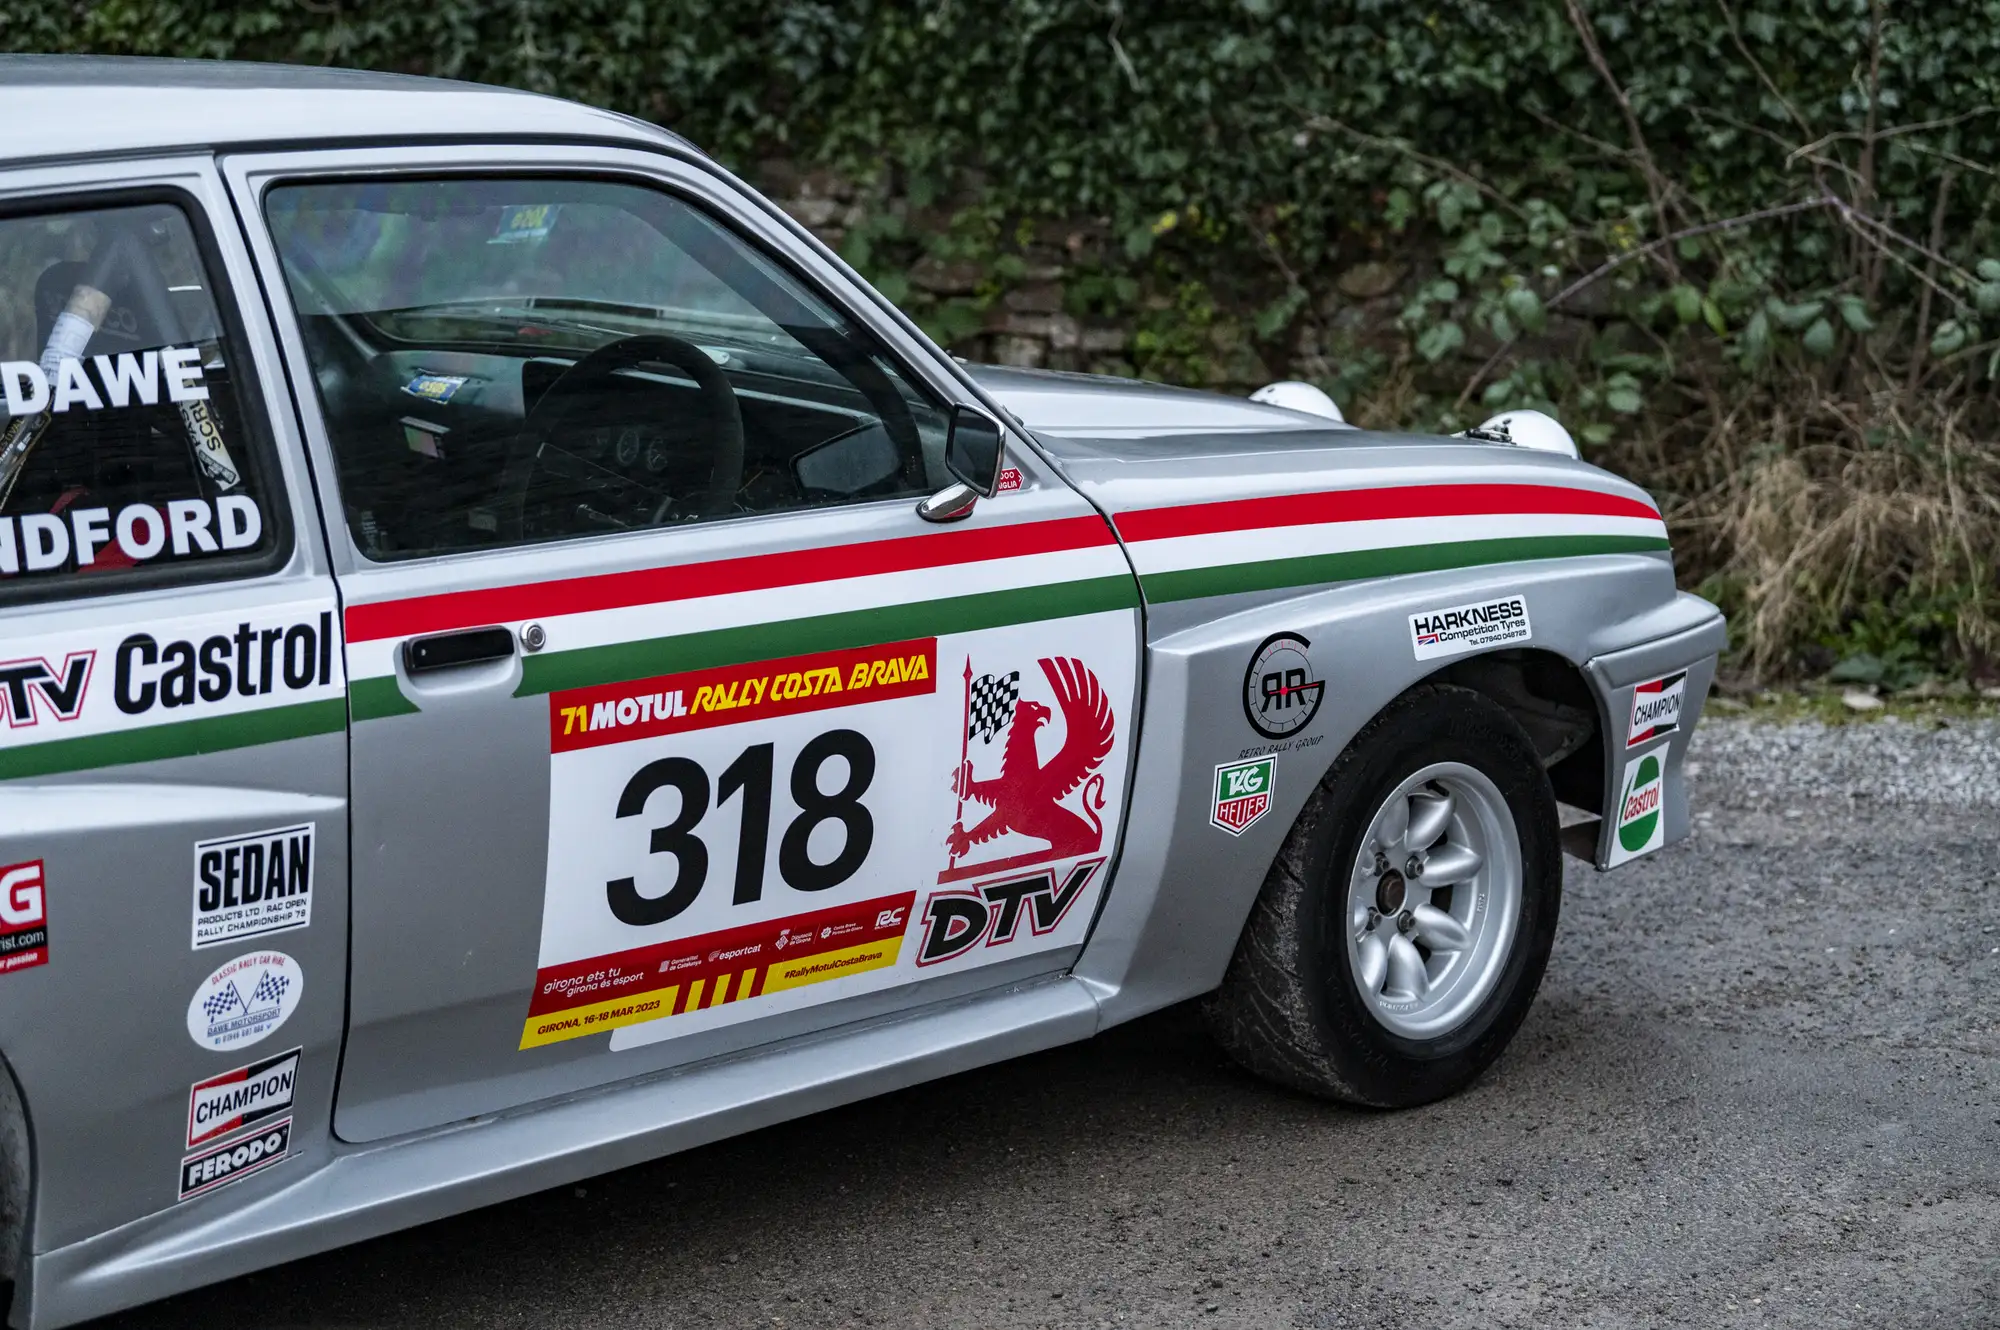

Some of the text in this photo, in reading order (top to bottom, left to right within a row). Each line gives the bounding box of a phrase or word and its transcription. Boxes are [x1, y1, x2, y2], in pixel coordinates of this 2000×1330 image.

[0, 348, 210, 416] DAWE
[1413, 600, 1524, 635] HARKNESS
[1439, 619, 1526, 642] Competition Tyres
[114, 611, 332, 715] Castrol
[0, 649, 97, 728] TV
[588, 689, 688, 731] MOTUL
[690, 676, 769, 714] RALLY
[769, 666, 843, 701] COSTA
[847, 654, 929, 690] BRAVA
[1634, 692, 1681, 726] CHAMPION
[1238, 735, 1324, 759] RETRO RALLY GROUP
[1227, 766, 1264, 795] TAG
[1219, 796, 1265, 826] HEUER
[1623, 781, 1660, 821] Castrol
[606, 728, 876, 927] 318
[199, 834, 310, 912] SEDAN
[197, 925, 225, 938] RALLY
[227, 912, 293, 932] CHAMPIONSHIP
[198, 910, 243, 926] PRODUCTS
[245, 907, 260, 917] LTD
[266, 902, 284, 913] RAC
[285, 898, 307, 909] OPEN
[916, 856, 1107, 968] DTV
[719, 944, 761, 960] esportcat
[784, 952, 882, 979] #RallyMotulCostaBrava
[211, 964, 237, 985] CLASSIC
[238, 957, 257, 970] RALLY
[259, 955, 271, 965] CAR
[543, 966, 622, 994] girona ets tu
[566, 982, 598, 998] girona
[613, 971, 645, 987] esport
[207, 1023, 230, 1036] DAWE
[230, 1007, 281, 1029] MOTORSPORT
[537, 999, 661, 1035] GIRONA, 16-18 MAR 2023
[196, 1070, 293, 1124] CHAMPION
[188, 1132, 282, 1187] FERODO
